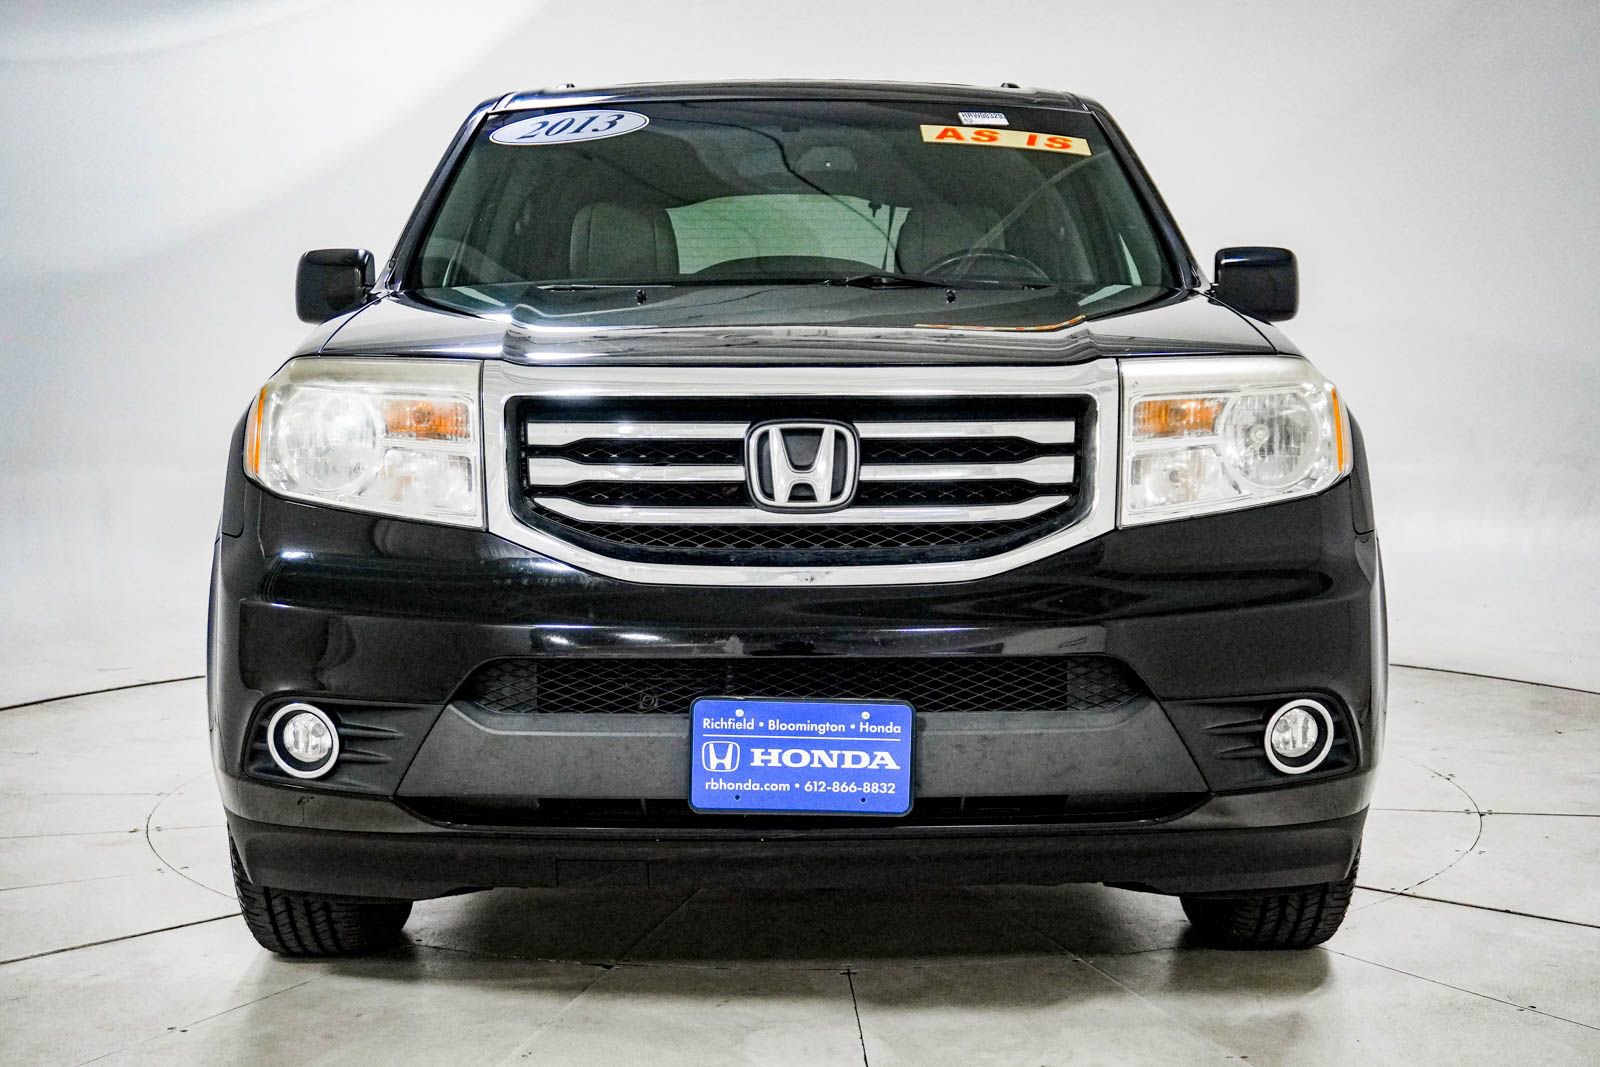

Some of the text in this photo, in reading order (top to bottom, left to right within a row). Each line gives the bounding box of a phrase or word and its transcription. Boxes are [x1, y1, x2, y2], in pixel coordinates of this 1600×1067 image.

[516, 113, 625, 140] 2013
[935, 127, 1073, 150] AS IS
[702, 717, 901, 734] Richfield Bloomington Honda
[749, 747, 901, 770] HONDA
[705, 778, 896, 794] rbhonda.com 612-866-8832
